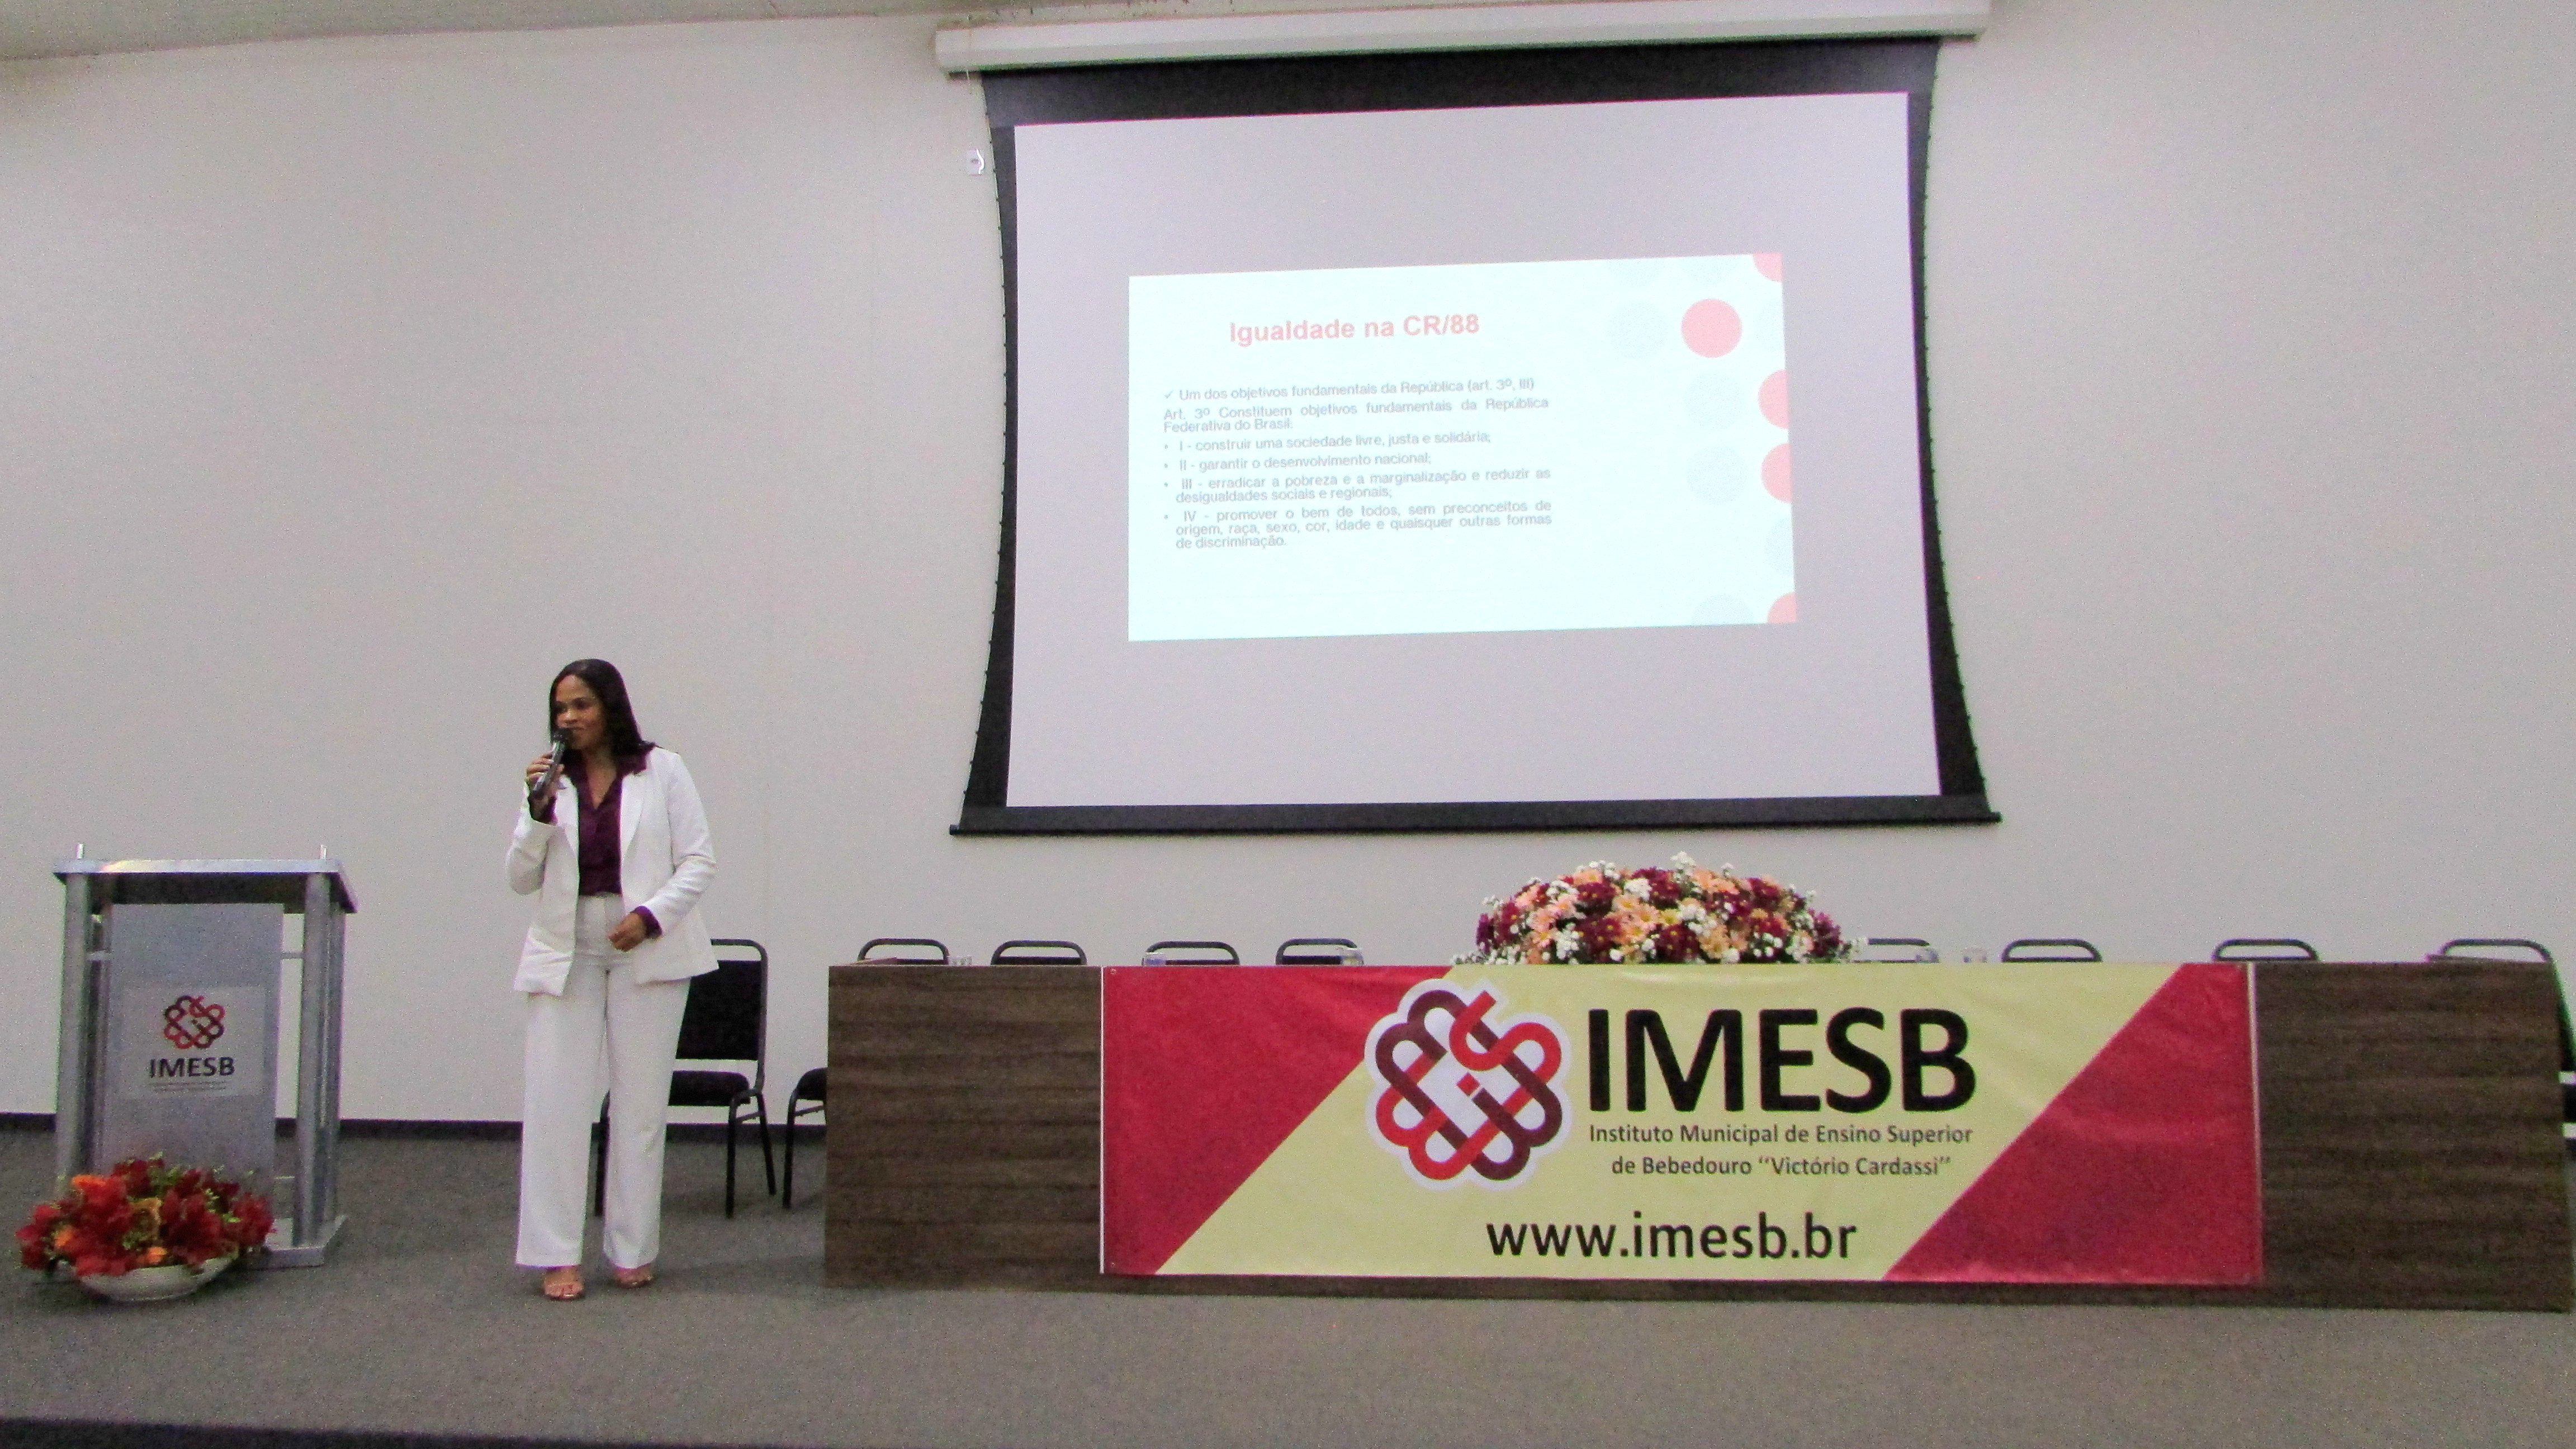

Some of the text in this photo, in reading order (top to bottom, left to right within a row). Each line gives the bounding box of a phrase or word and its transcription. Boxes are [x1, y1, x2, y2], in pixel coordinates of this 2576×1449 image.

[1230, 314, 1479, 347] Igualdade na CR/88
[1179, 389, 1201, 400] Um
[1204, 389, 1228, 400] dos
[1230, 387, 1288, 401] objetivos
[1291, 383, 1377, 396] fundamentais
[1381, 382, 1397, 394] da
[1400, 381, 1464, 395] República
[1467, 379, 1492, 392] (art.
[1163, 408, 1186, 420] Art.
[1218, 405, 1292, 418] Constituem
[1300, 403, 1358, 418] objetivos
[1366, 400, 1452, 413] fundamentais
[1461, 399, 1477, 410] da
[1485, 396, 1549, 411] República
[1164, 419, 1231, 433] Federativa
[1234, 420, 1251, 430] do
[1195, 438, 1252, 451] construir
[1256, 439, 1283, 449] uma
[1286, 435, 1352, 448] sociedade
[1388, 433, 1419, 447] justa
[1422, 434, 1431, 444] e
[1199, 458, 1248, 473] garantir
[1252, 459, 1261, 468] o
[1264, 454, 1371, 468] desenvolvimento
[1208, 476, 1266, 489] erradicar
[1272, 477, 1280, 487] a
[1285, 475, 1338, 489] pobreza
[1343, 475, 1352, 485] e
[1357, 475, 1365, 485] a
[1370, 470, 1467, 486] marginalização
[1471, 471, 1480, 481] e
[1485, 468, 1530, 480] reduzir
[1536, 469, 1551, 479] as
[1175, 486, 1392, 505] desigualdades sociais e regionais;
[1183, 510, 1197, 522] IV
[1216, 510, 1278, 523] promover
[1285, 509, 1294, 519] o
[1301, 507, 1329, 518] bem
[1337, 505, 1353, 518] de
[1408, 505, 1436, 515] sem
[1443, 501, 1528, 517] preconceitos
[1535, 500, 1551, 511] de
[1176, 524, 1223, 538] origem,
[1229, 524, 1260, 536] raça,
[1266, 523, 1300, 534] sexo,
[1336, 519, 1371, 531] idade
[1376, 520, 1385, 529] e
[1390, 518, 1453, 531] quaisquer
[1460, 515, 1501, 527] outras
[1507, 514, 1552, 525] formas
[1176, 535, 1286, 550] de discriminação.
[150, 1057, 234, 1078] IMESB
[1589, 1007, 1976, 1114] IMESB
[1590, 1124, 1973, 1147] Instituto Municipal de Ensino Superior
[1612, 1156, 1636, 1175] de
[1642, 1156, 1752, 1175] Bebedouro
[1487, 1211, 1857, 1259] www.imesb.br
